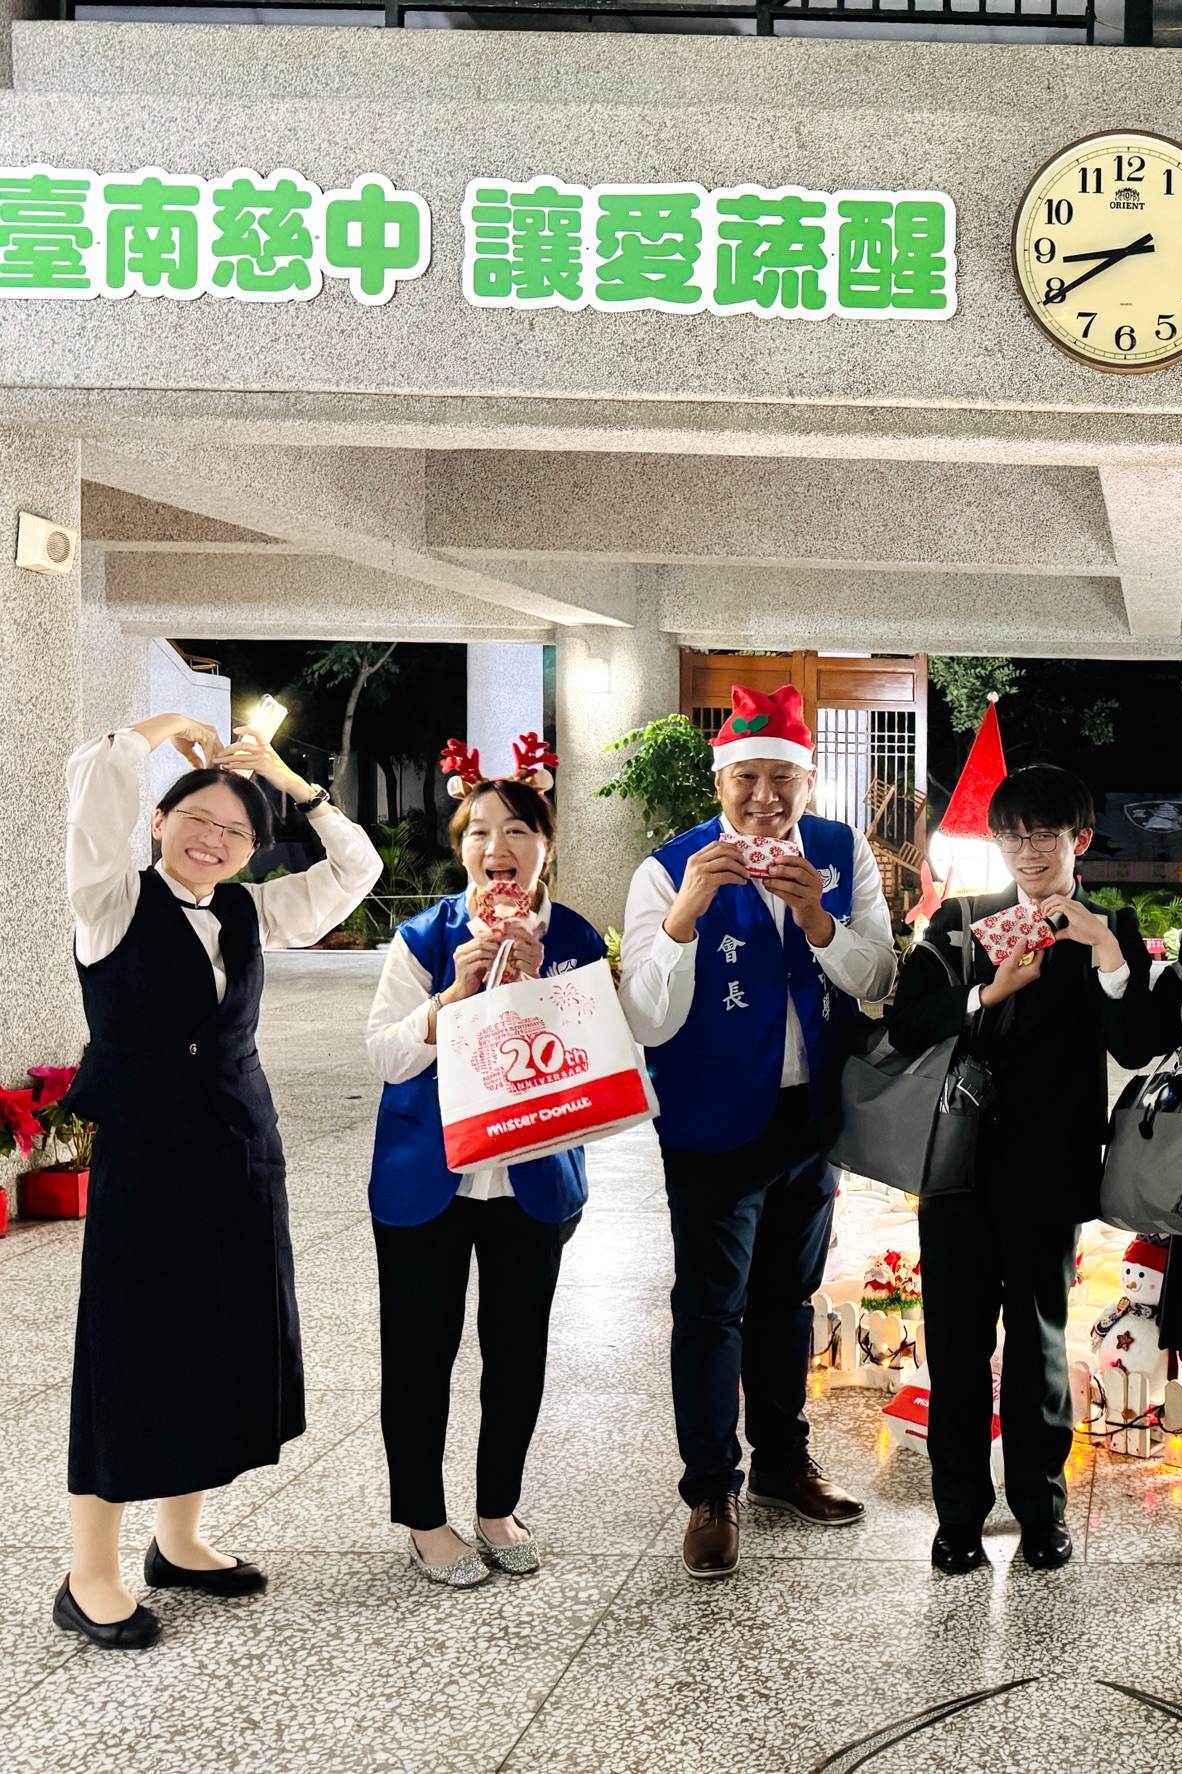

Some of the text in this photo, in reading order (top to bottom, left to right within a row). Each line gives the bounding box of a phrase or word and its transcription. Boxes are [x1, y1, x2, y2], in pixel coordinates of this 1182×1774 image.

[1078, 167, 1104, 194] 11
[1114, 155, 1146, 182] 12
[1163, 169, 1175, 195] 1
[1044, 198, 1073, 225] 10
[1109, 201, 1146, 210] ORIENT
[0, 176, 947, 310] 臺南慈中 讓愛蔬醒
[1034, 237, 1056, 263] 9
[1044, 277, 1067, 304] 8
[1076, 312, 1098, 338] 7
[1114, 325, 1137, 351] 6
[1154, 314, 1177, 340] 5
[717, 934, 750, 1012] 會長
[499, 1030, 588, 1082] 20th
[539, 1097, 592, 1121] Donut
